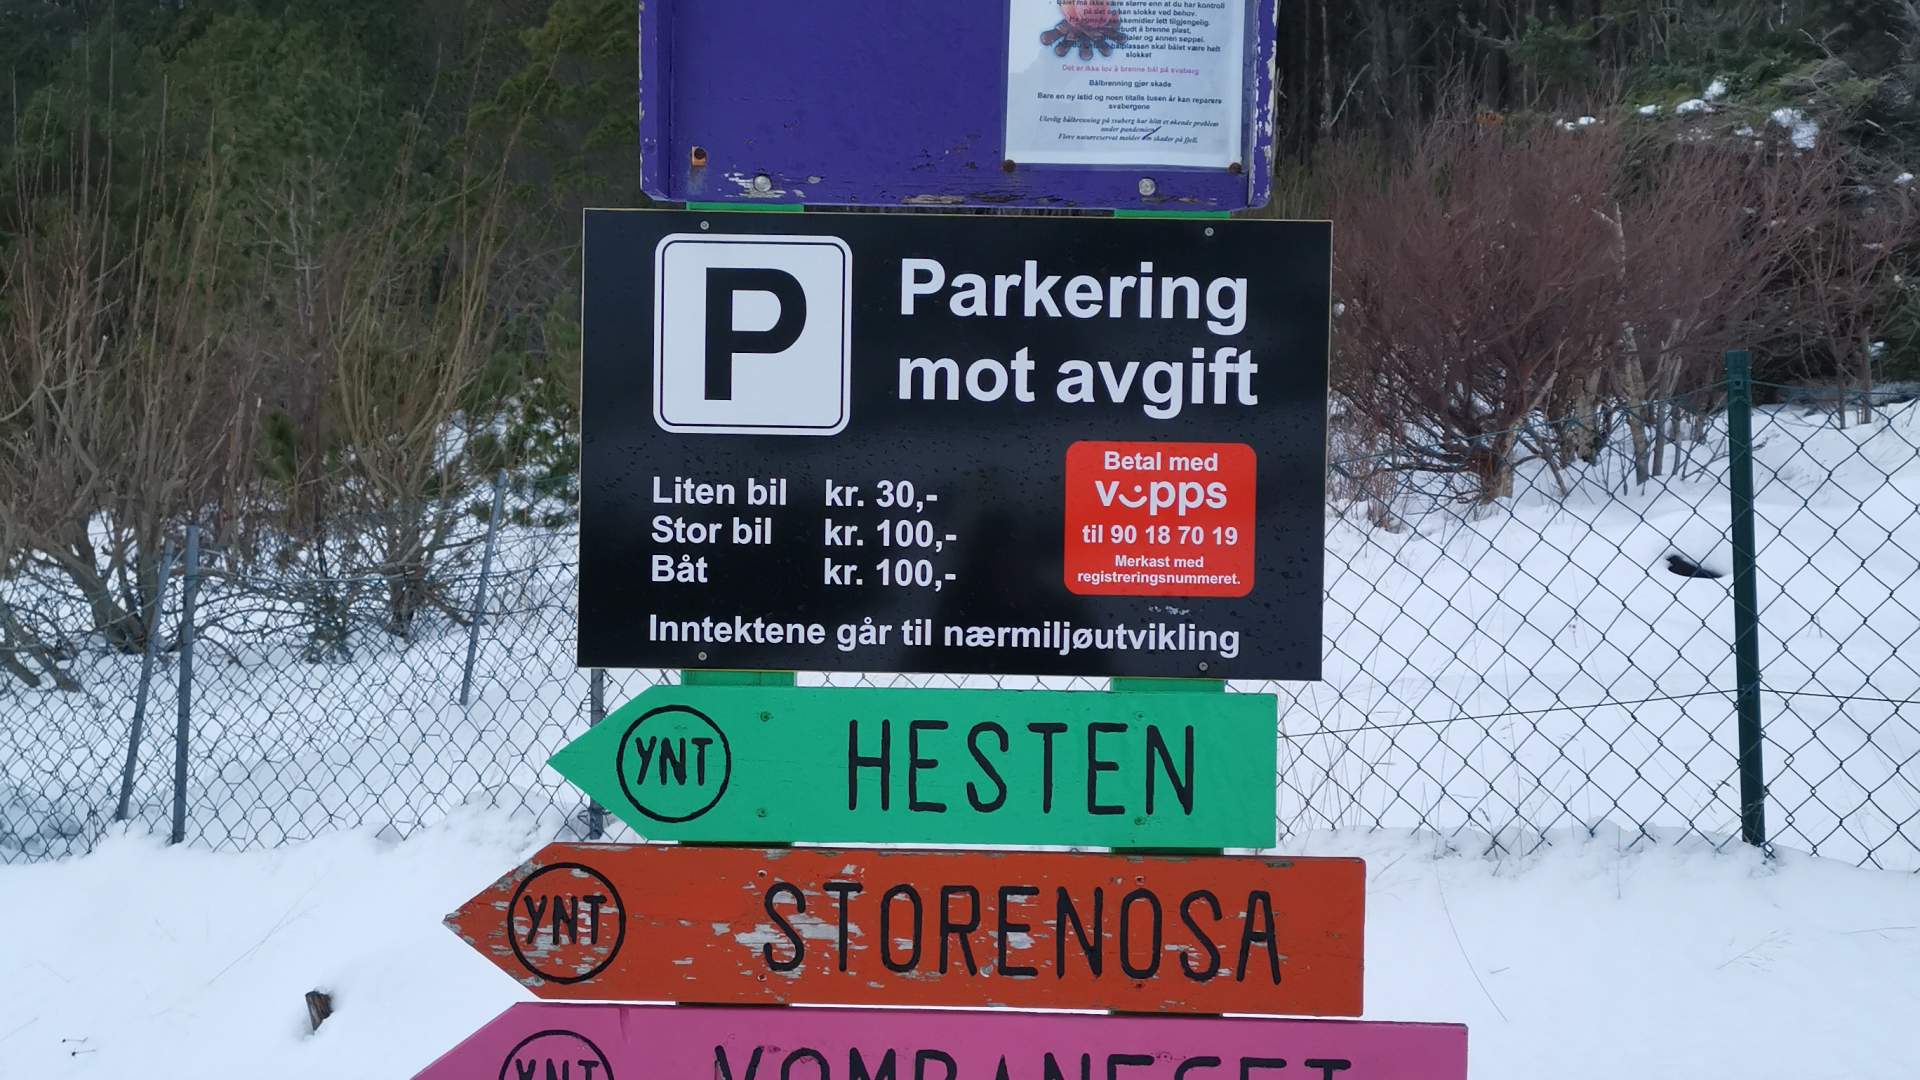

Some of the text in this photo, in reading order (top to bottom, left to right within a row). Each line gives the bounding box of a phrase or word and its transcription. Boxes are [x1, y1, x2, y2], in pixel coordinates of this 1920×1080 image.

[1089, 79, 1132, 88] Bålbrenning
[902, 259, 1247, 334] Parkering
[705, 268, 806, 400] P
[899, 347, 1257, 419] mot avgift
[1105, 451, 1217, 471] Betal med
[654, 477, 937, 512] Liten bil kr. 30,-
[652, 516, 956, 552] Stor bil kr. 100,-
[1083, 525, 1237, 545] til 90 18 70 19
[652, 555, 955, 591] Båt kr. 100,-
[1078, 571, 1240, 586] registreringsnummeret.
[1116, 555, 1203, 567] Merkast med
[650, 615, 1239, 658] Inntektene går til nærmiljøutvikling
[636, 720, 1193, 815] YNT HESTEN
[524, 879, 1281, 985] YNT STORENOSA
